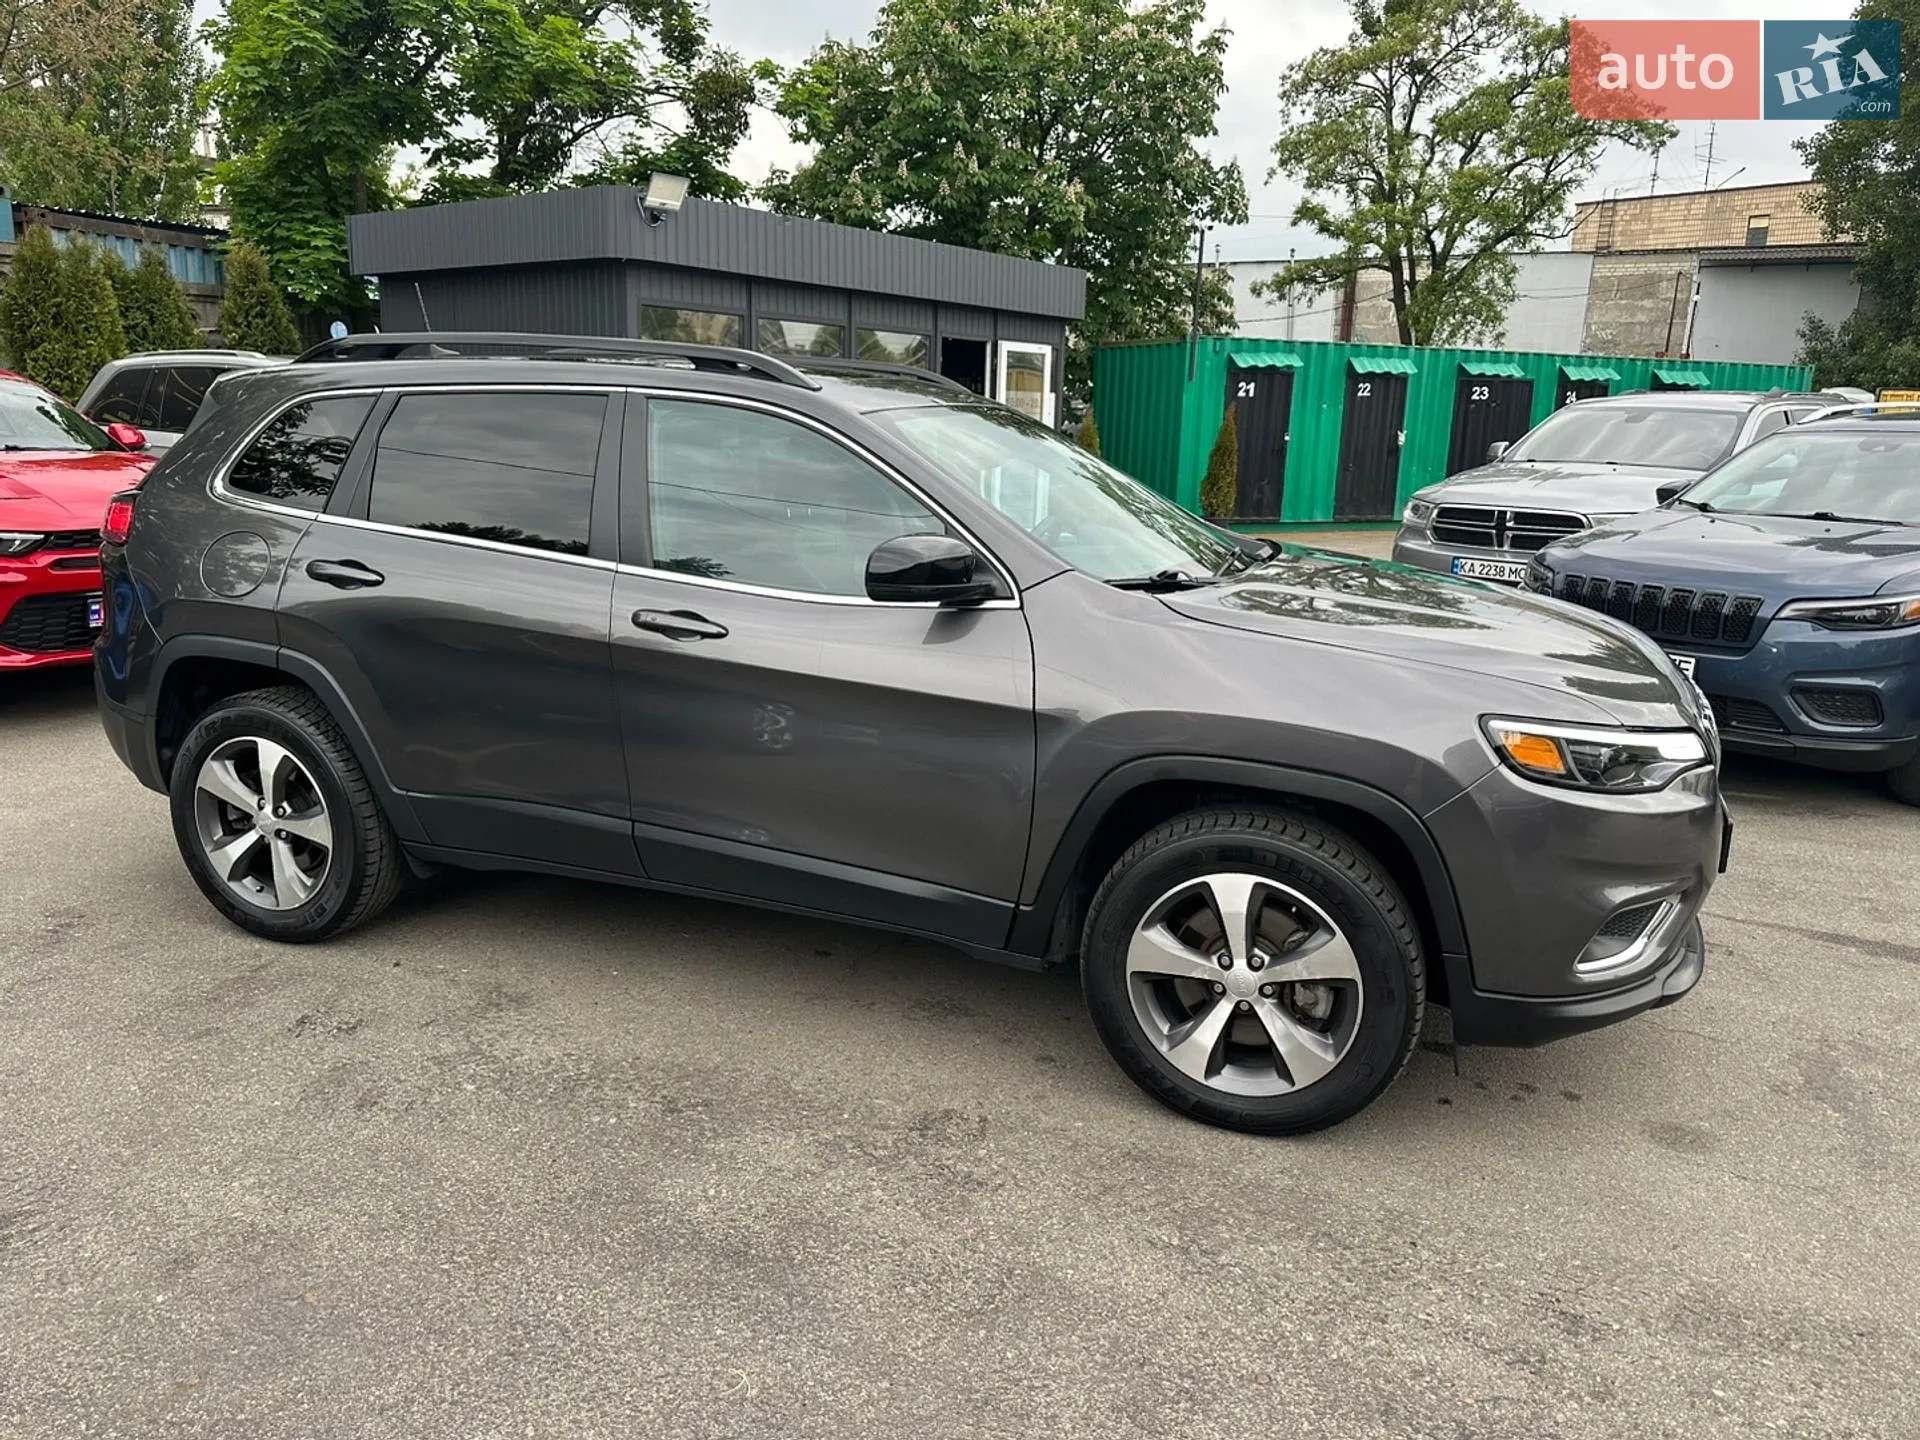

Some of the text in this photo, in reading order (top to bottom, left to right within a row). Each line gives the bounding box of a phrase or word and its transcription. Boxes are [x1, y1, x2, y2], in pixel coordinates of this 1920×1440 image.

[1237, 382, 1256, 397] 21
[1357, 382, 1372, 396] 22
[1471, 386, 1490, 400] 23
[1565, 390, 1577, 404] 24
[1460, 561, 1475, 574] KA
[1478, 563, 1506, 578] 2238
